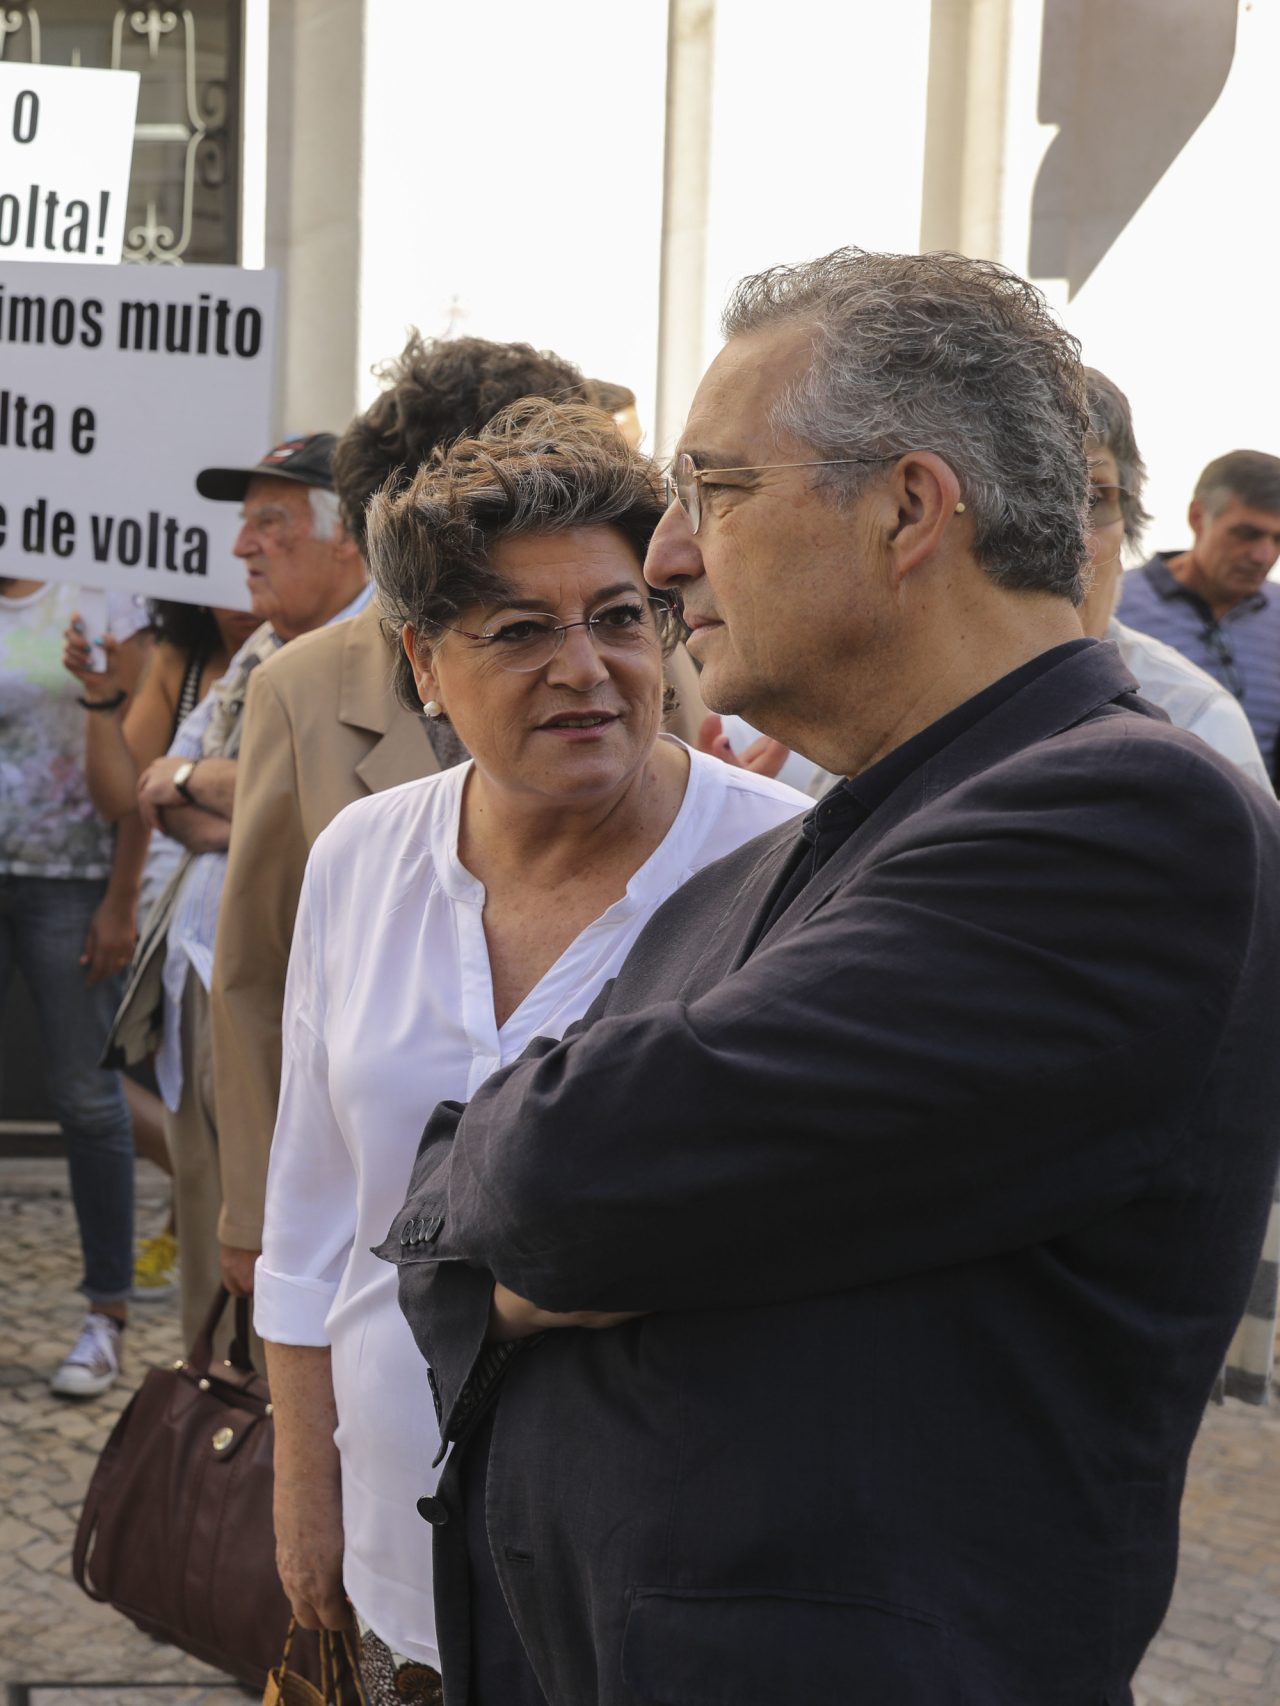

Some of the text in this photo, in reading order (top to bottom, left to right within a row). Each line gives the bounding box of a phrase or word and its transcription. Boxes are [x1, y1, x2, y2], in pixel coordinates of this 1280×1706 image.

[11, 89, 41, 144] o
[118, 294, 262, 358] muito
[71, 405, 96, 455] e
[22, 498, 77, 558] de
[90, 511, 209, 576] volta
